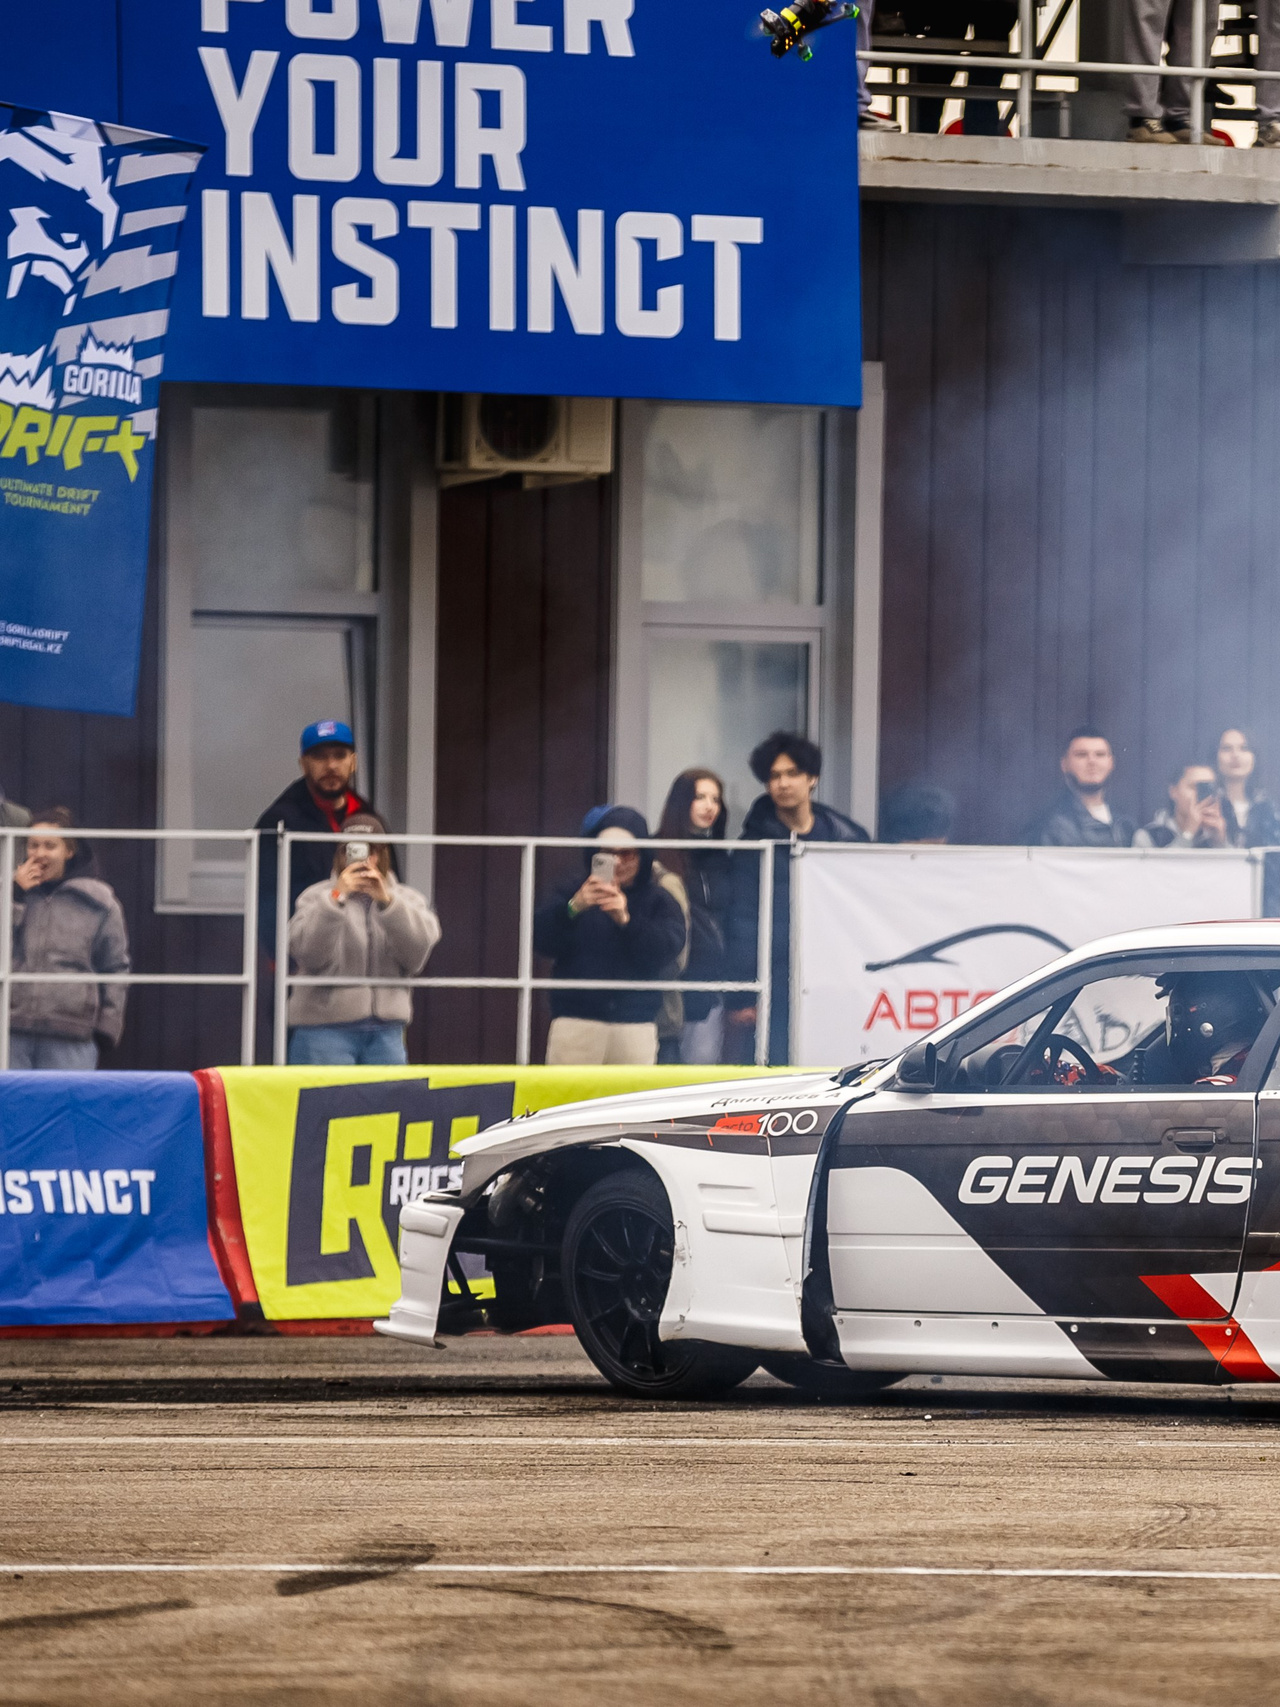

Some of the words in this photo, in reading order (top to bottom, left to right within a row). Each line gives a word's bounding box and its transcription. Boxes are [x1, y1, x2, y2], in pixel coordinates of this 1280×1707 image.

[198, 46, 527, 192] YOUR
[201, 189, 764, 342] INSTINCT
[63, 365, 142, 405] GORILLA
[4, 492, 92, 516] TOURNAMENT
[57, 485, 100, 502] DRIFT
[0, 1168, 156, 1215] STINCT
[958, 1155, 1263, 1204] GENESIS
